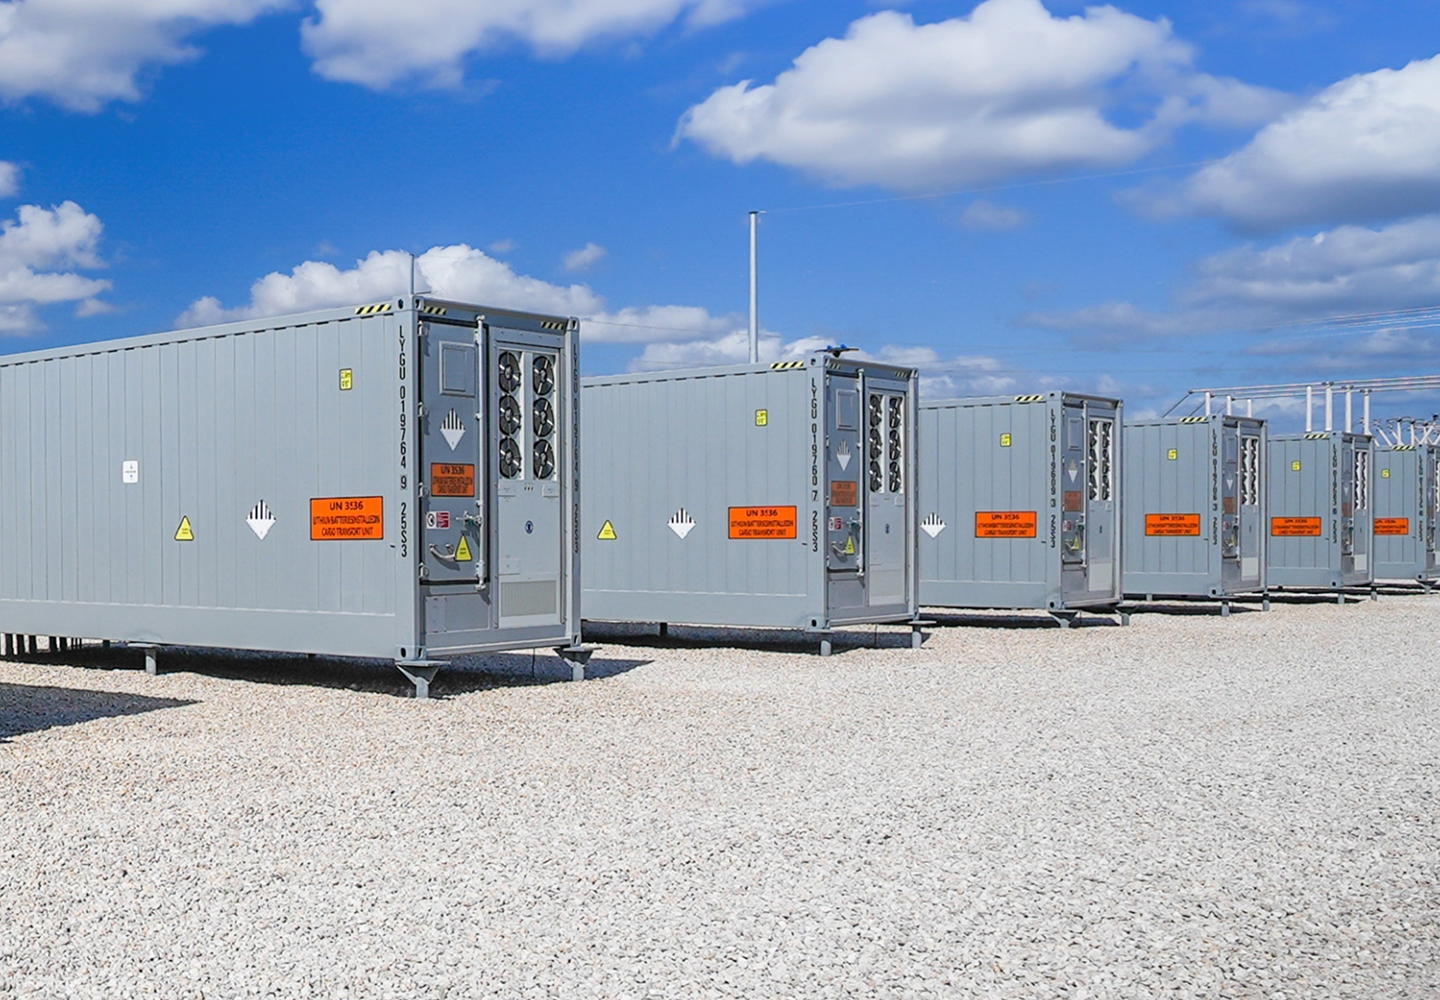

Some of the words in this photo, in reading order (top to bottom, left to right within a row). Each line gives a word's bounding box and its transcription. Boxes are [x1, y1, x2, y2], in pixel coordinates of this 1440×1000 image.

[401, 475, 407, 489] 9
[812, 491, 818, 501] 7
[329, 501, 343, 511] UN
[345, 501, 364, 511] 3536
[746, 509, 758, 517] UN
